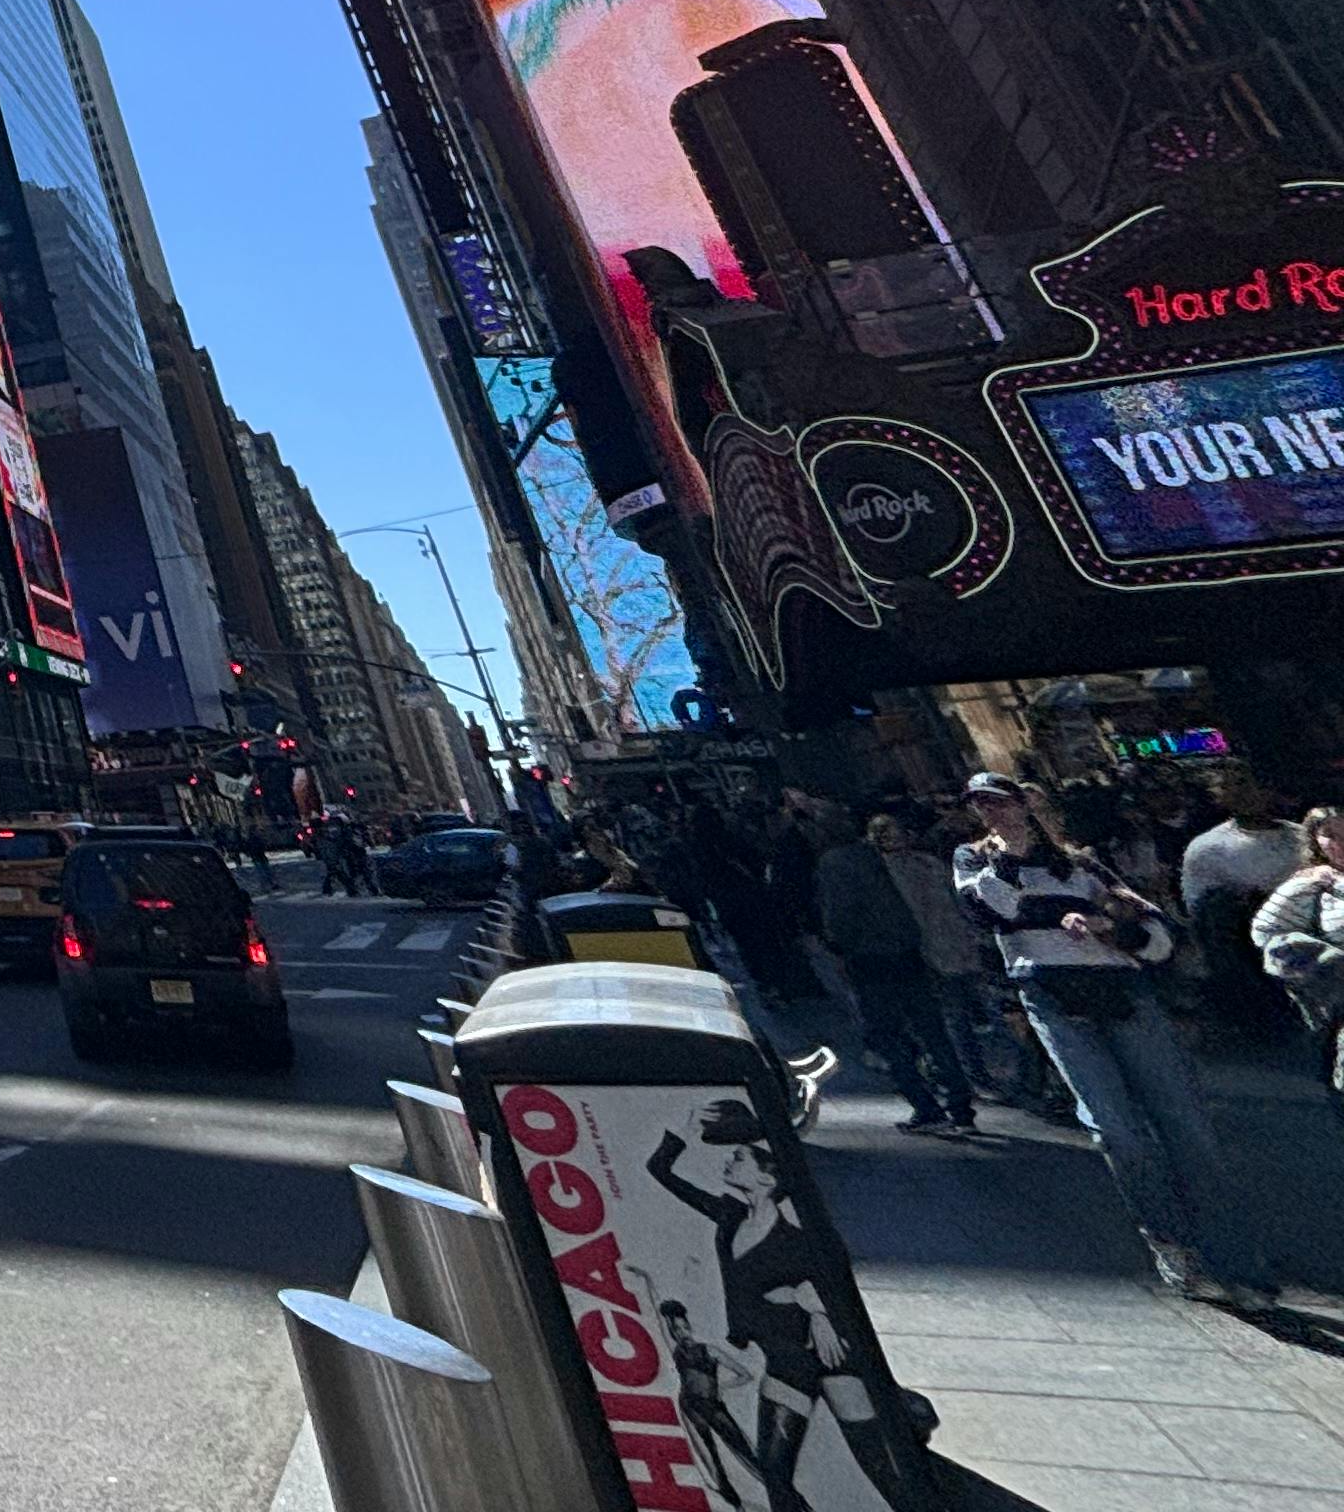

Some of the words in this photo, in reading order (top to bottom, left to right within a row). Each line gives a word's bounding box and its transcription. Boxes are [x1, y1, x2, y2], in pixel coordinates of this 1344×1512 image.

[1127, 268, 1272, 328] Hard
[1280, 261, 1344, 313] Ro
[1092, 420, 1274, 491] YOUR
[1262, 406, 1344, 473] NE
[872, 489, 935, 522] Rock
[98, 589, 174, 663] vi
[578, 1099, 601, 1140] PARTY
[500, 1084, 712, 1512] HICAGO
